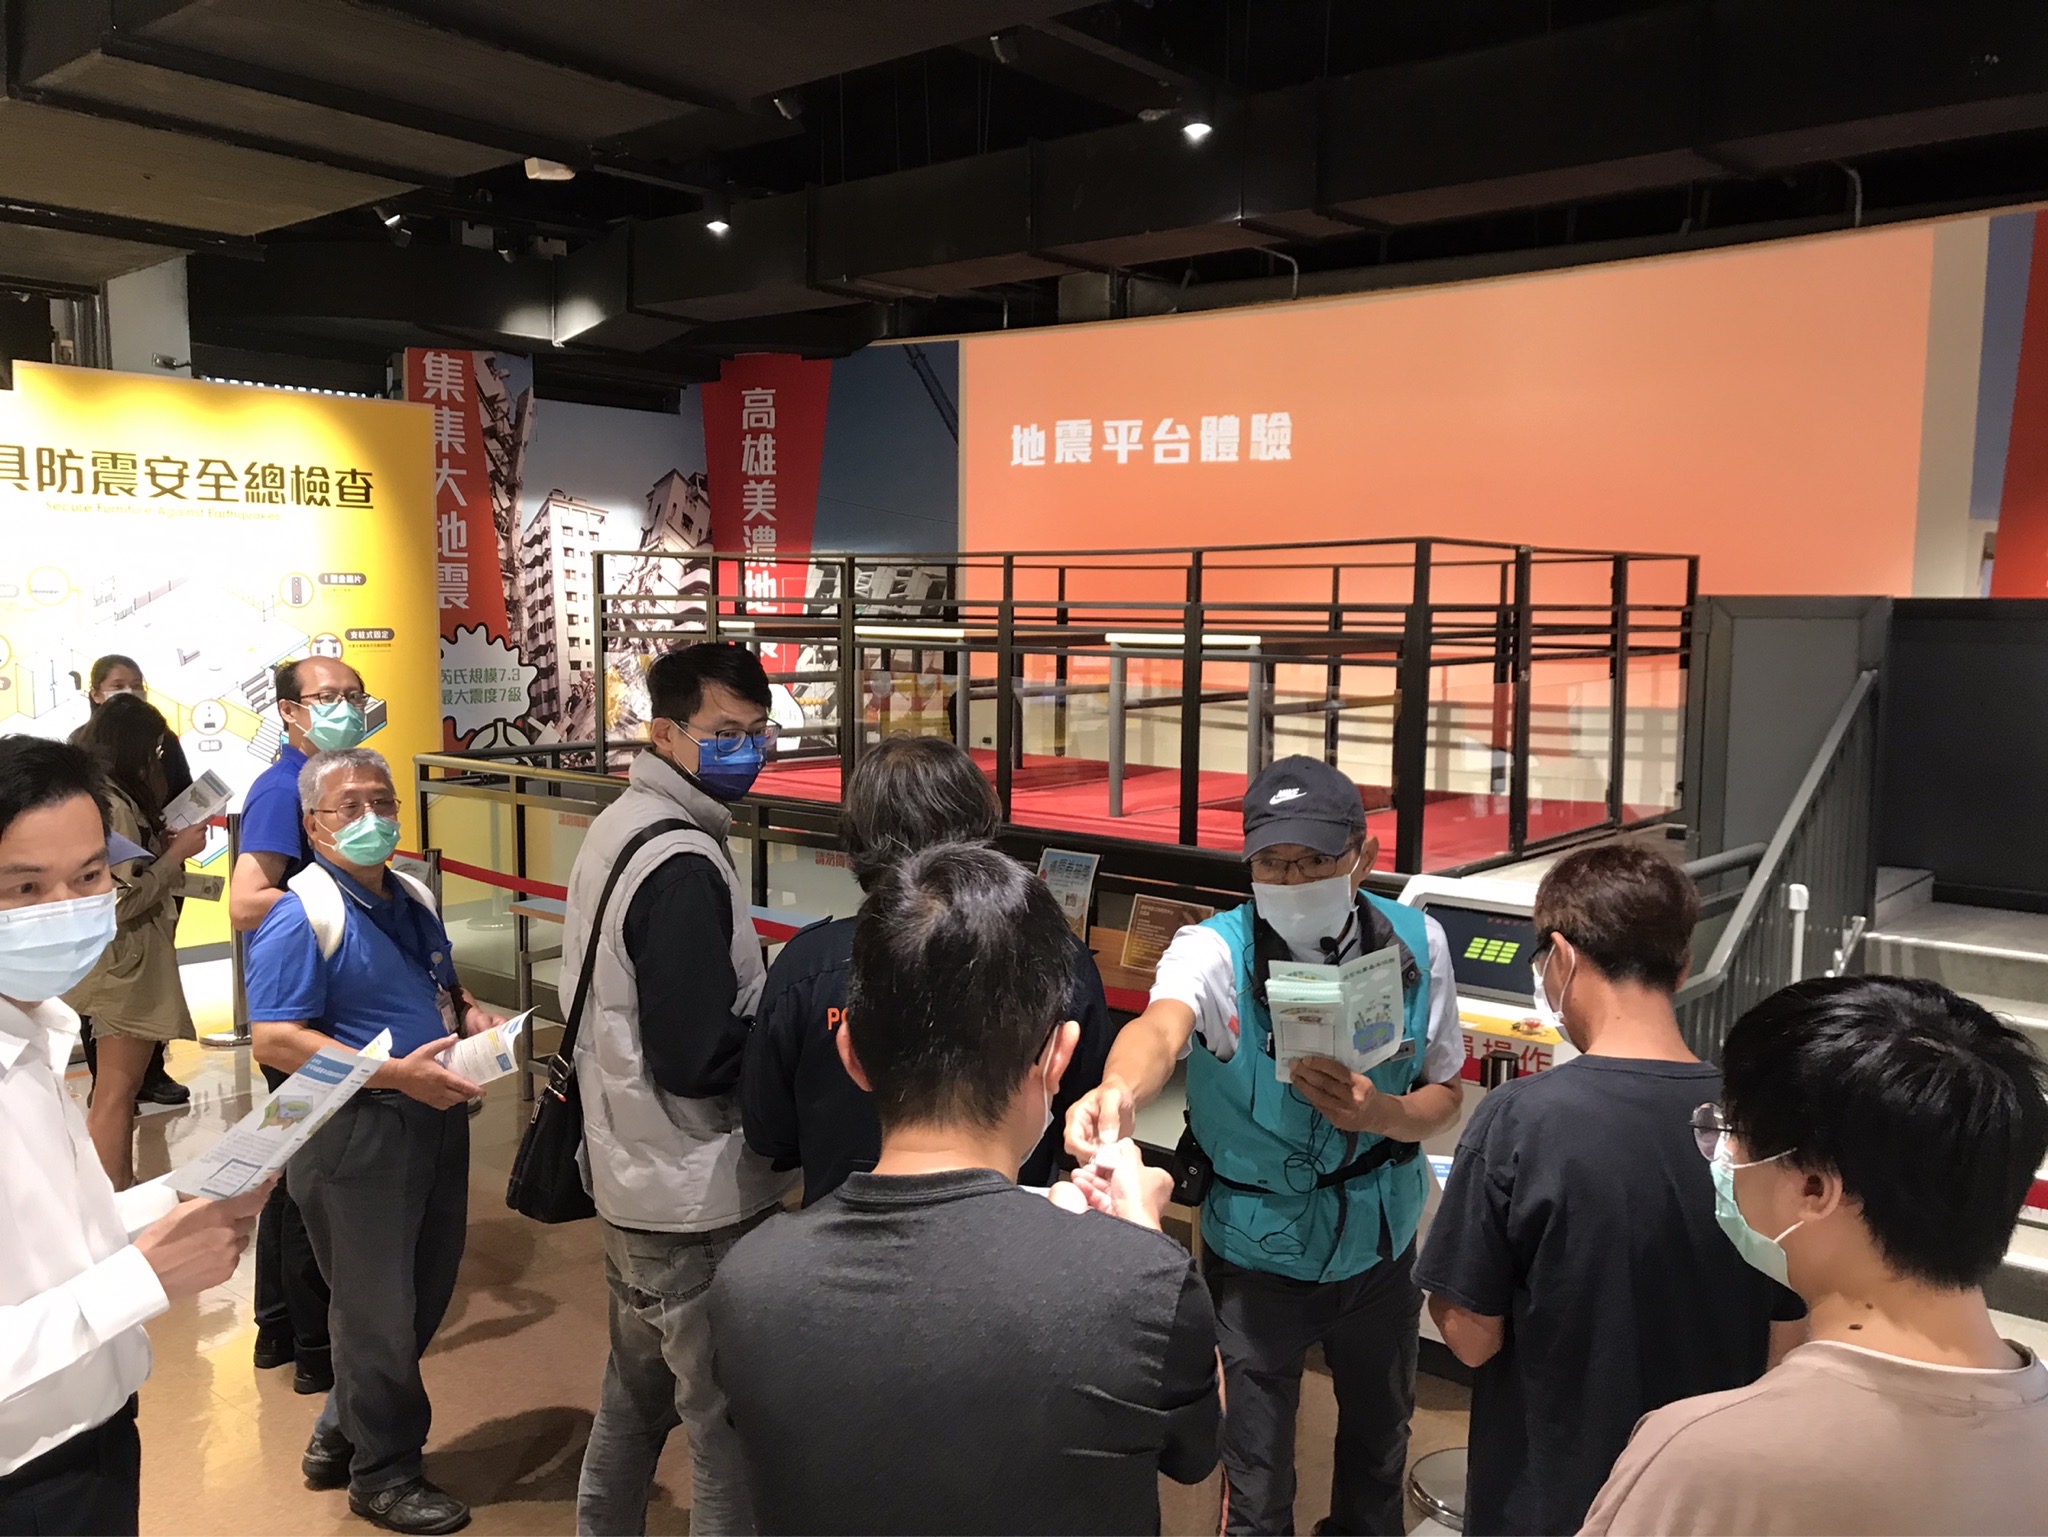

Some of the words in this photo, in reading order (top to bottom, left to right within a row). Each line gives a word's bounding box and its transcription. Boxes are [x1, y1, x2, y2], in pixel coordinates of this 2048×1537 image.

[1010, 412, 1293, 467] 地震平台體驗
[0, 444, 374, 509] 具防震安全總檢查
[423, 351, 470, 610] 集集大地震
[45, 501, 92, 514] Secure
[96, 502, 153, 516] Furniture
[157, 506, 205, 520] Against
[741, 387, 778, 656] 高雄美濃地
[441, 667, 521, 685] 芮氏規模7.3
[441, 686, 522, 705] 最大震度7級
